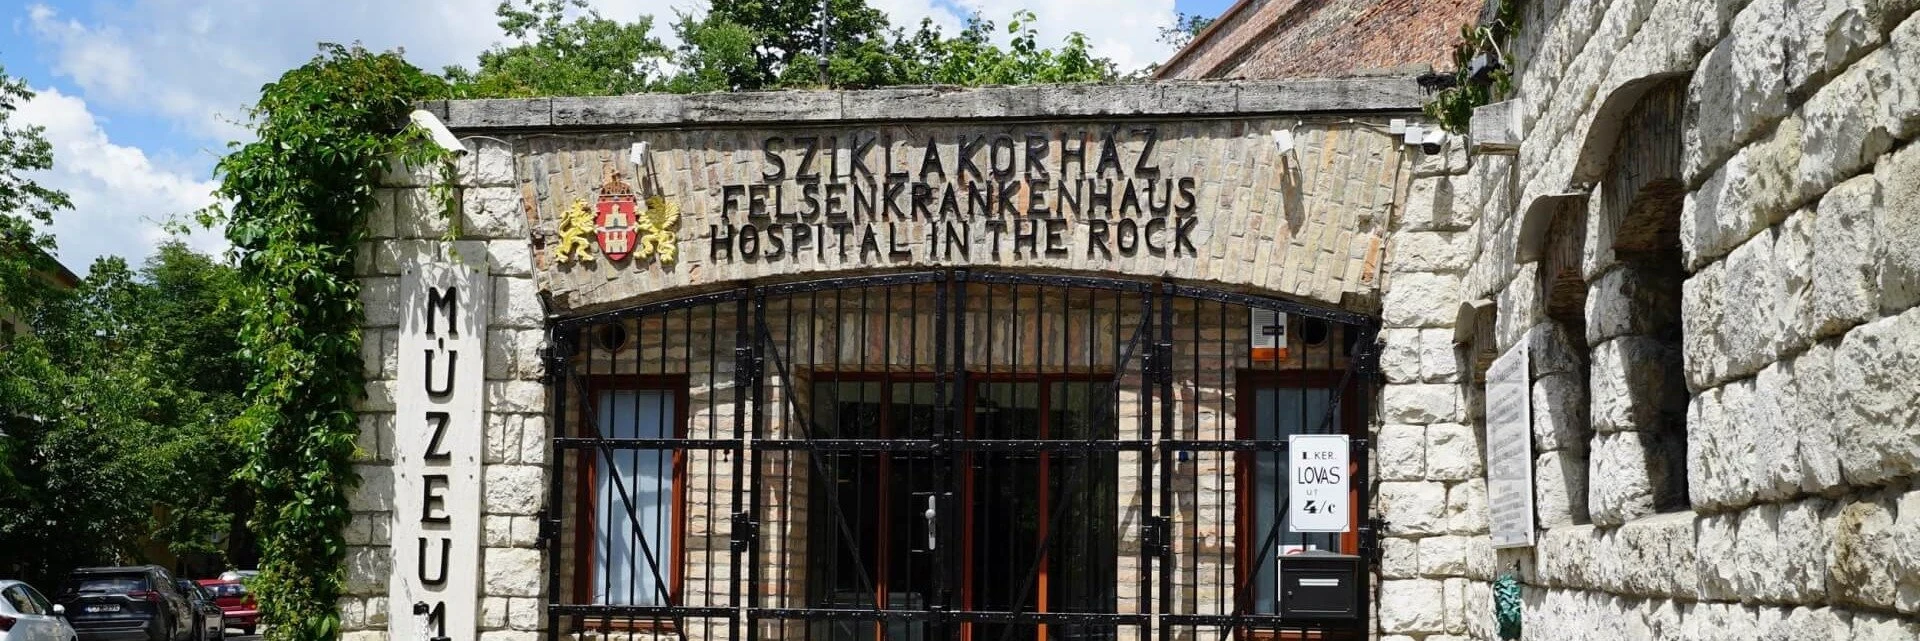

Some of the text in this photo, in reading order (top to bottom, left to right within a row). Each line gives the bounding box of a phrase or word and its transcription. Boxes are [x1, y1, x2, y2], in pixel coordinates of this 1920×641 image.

[721, 177, 1197, 221] FELSENKRANKENHAUS
[710, 217, 1197, 262] HOSPITAL IN THE ROCK
[1314, 451, 1336, 460] KER.
[1298, 466, 1340, 484] LOVAS
